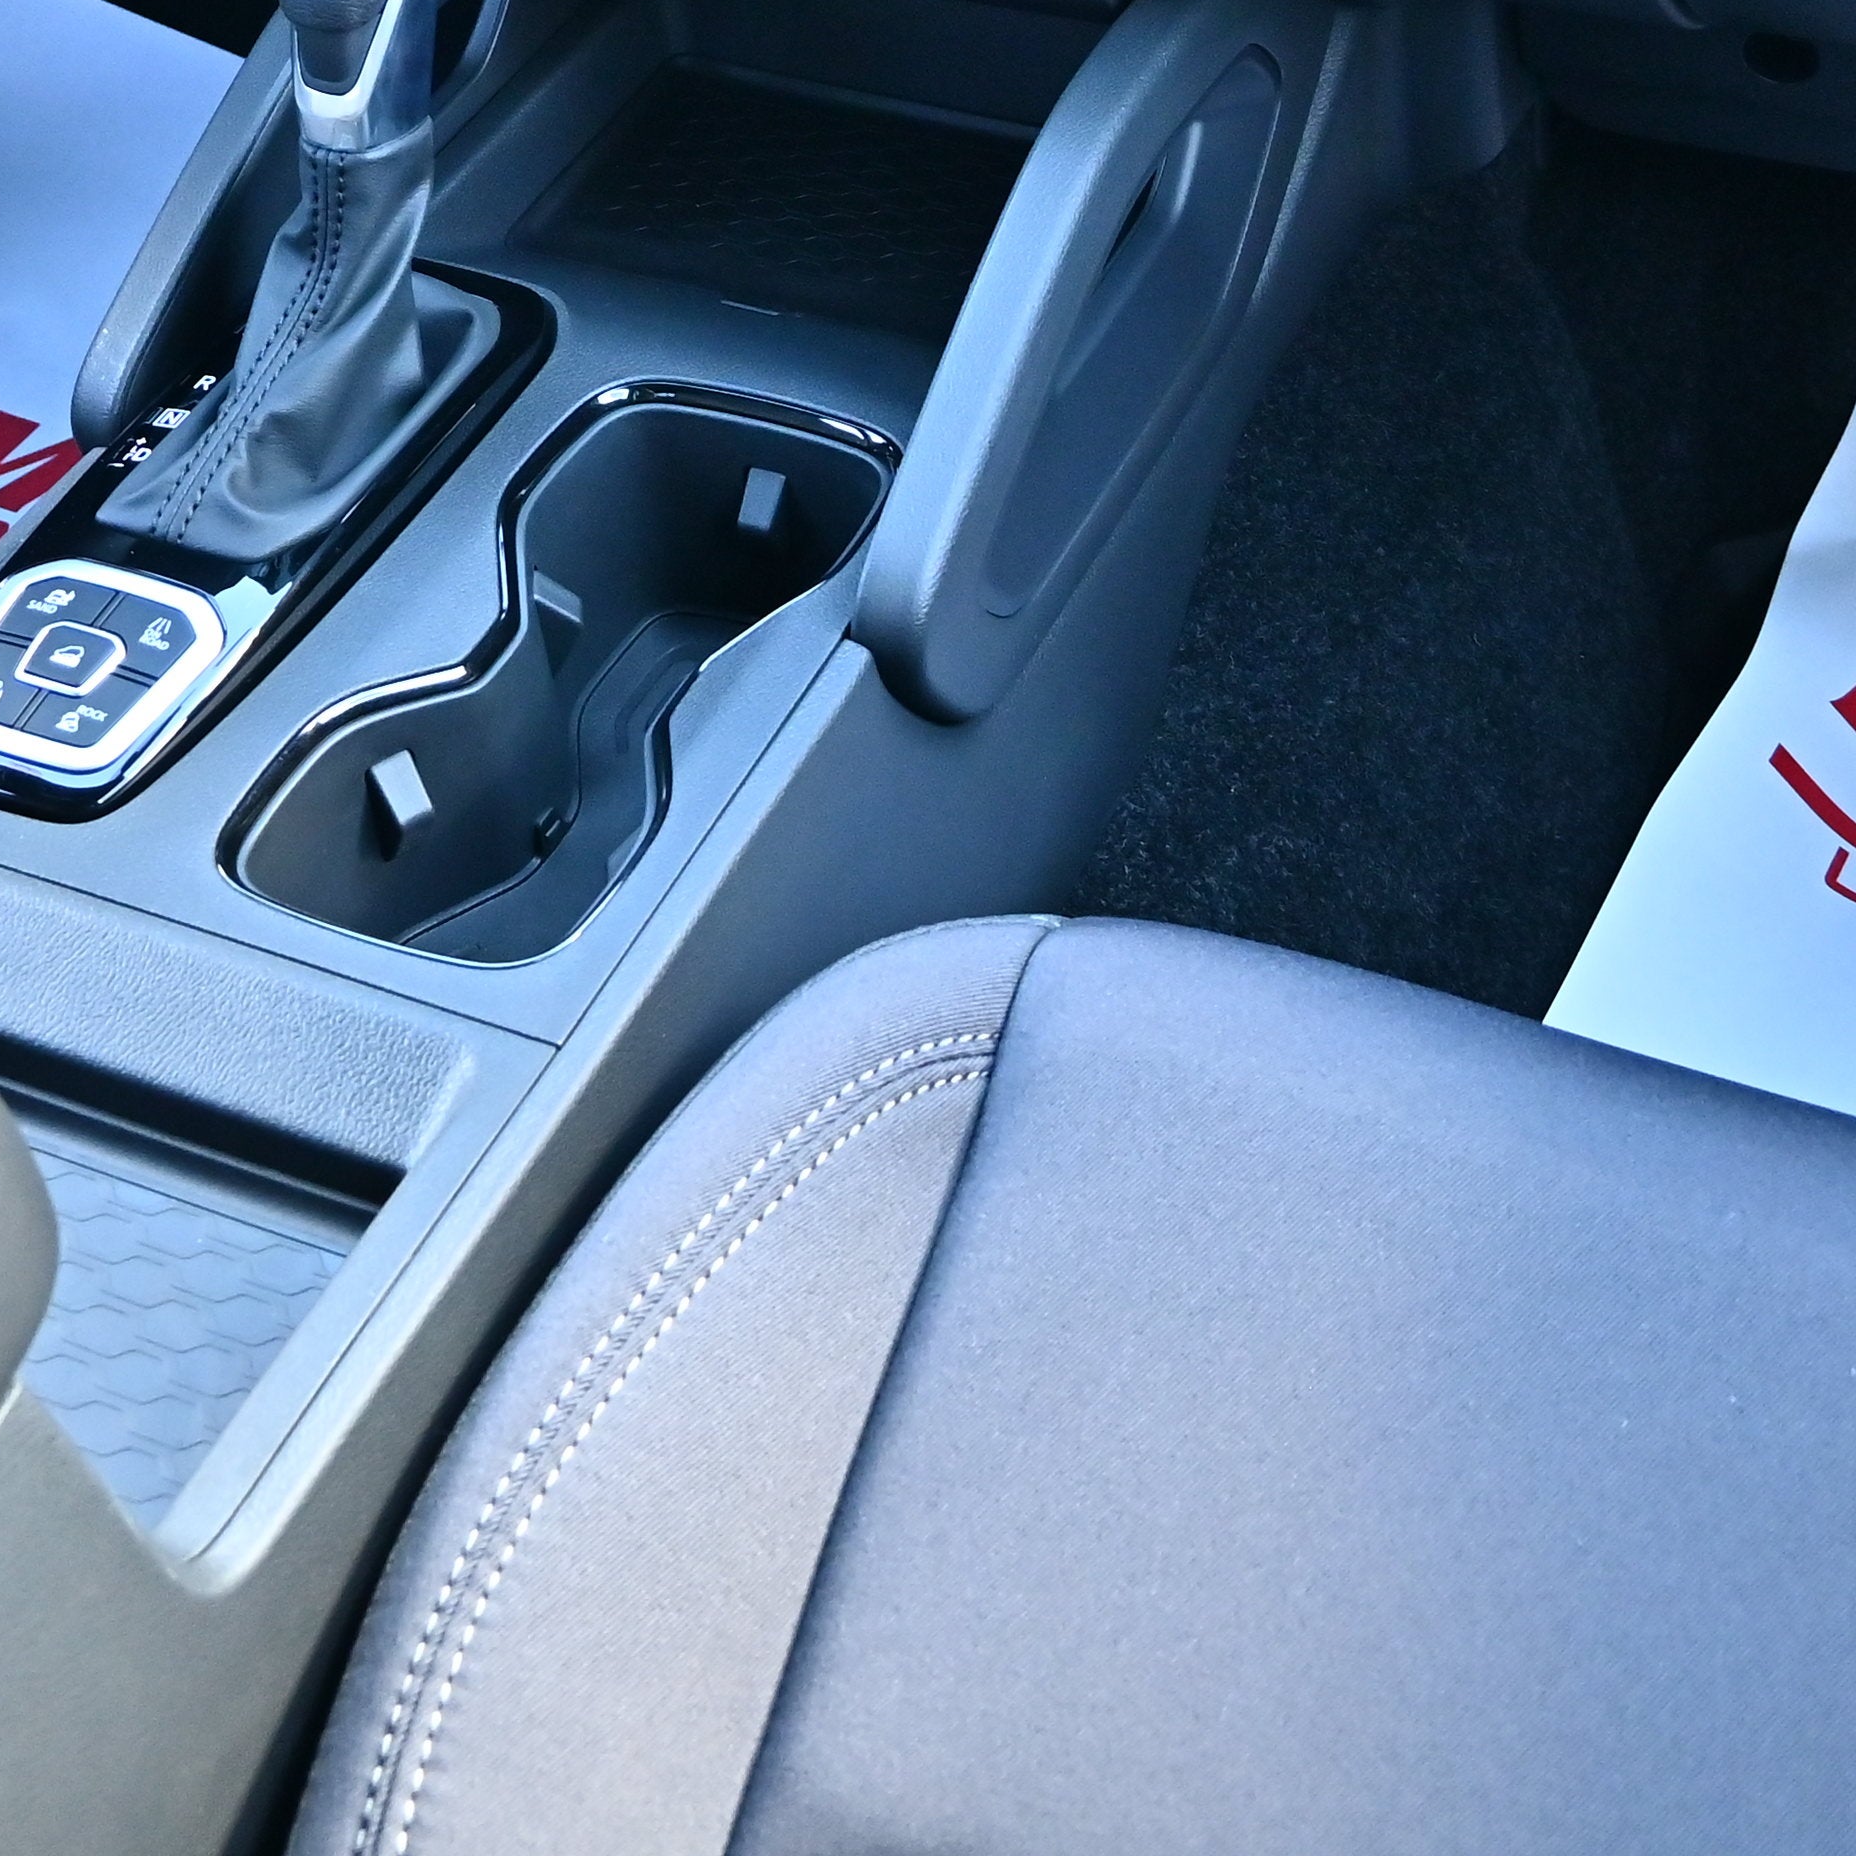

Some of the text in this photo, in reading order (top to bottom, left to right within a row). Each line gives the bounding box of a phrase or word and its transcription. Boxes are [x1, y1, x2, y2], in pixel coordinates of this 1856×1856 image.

[193, 374, 217, 391] R
[26, 599, 58, 615] SAND
[75, 704, 108, 722] ROCK
